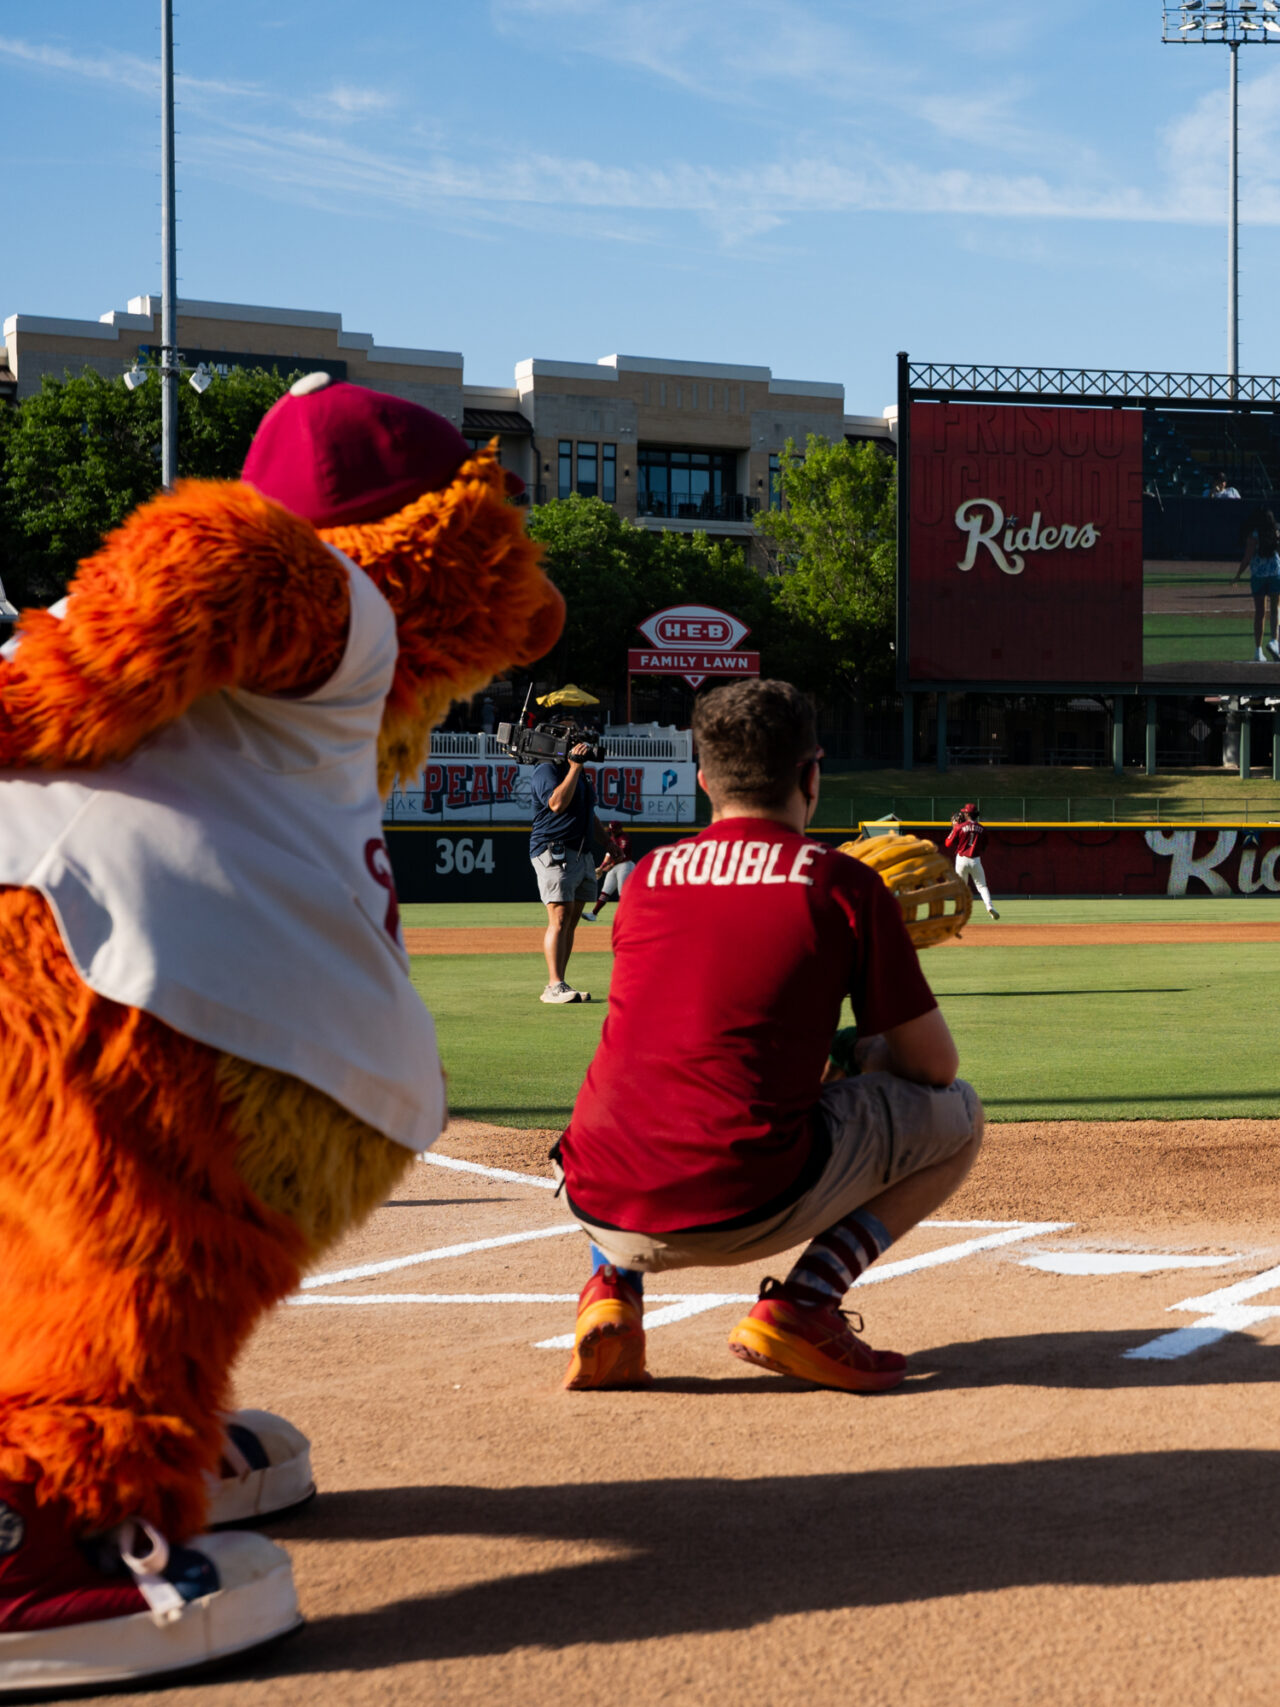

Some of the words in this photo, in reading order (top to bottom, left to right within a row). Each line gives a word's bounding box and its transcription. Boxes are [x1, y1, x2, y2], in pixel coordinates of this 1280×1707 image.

[955, 498, 1101, 575] Riders
[640, 655, 697, 668] FAMILY
[703, 656, 748, 669] LAWN
[422, 764, 520, 814] PEAK
[648, 801, 687, 812] PEAK
[435, 838, 496, 875] 364
[647, 840, 827, 888] TROUBLE
